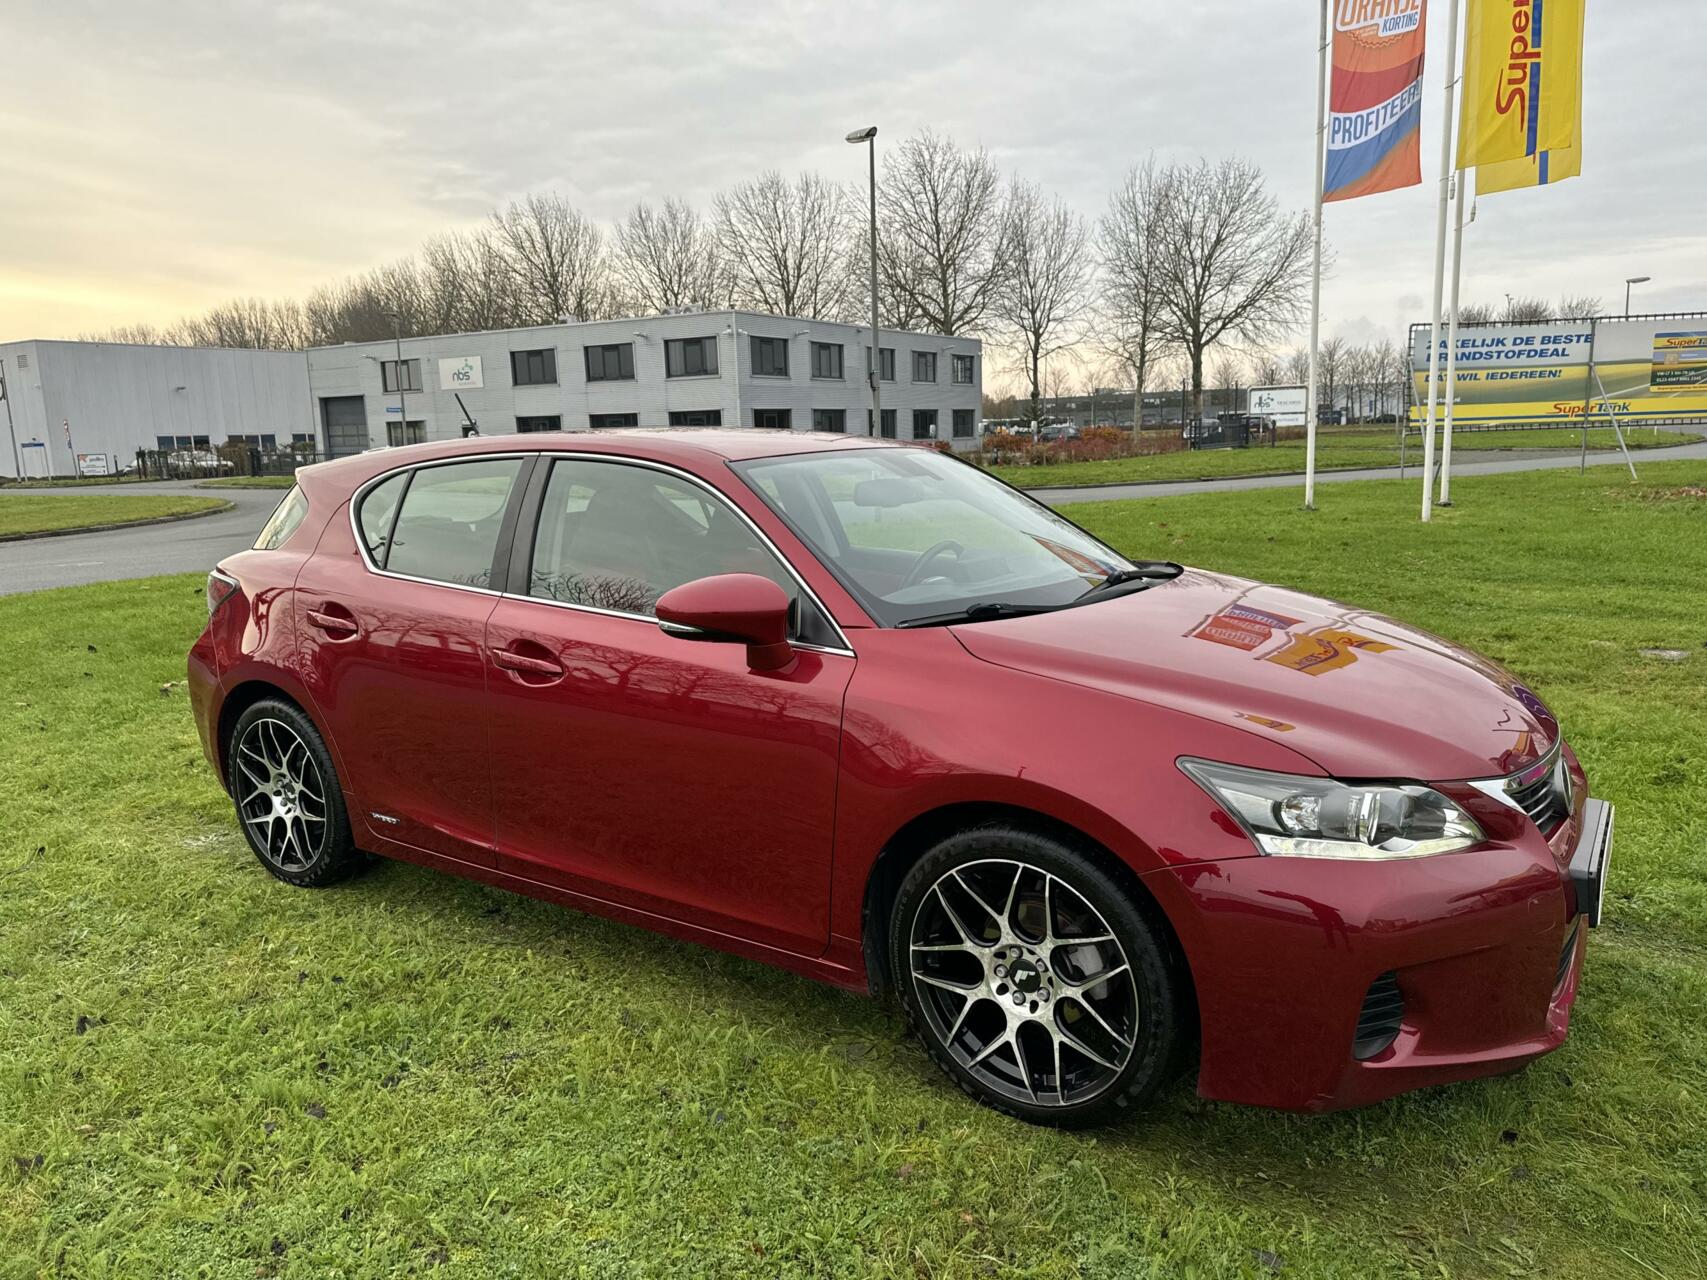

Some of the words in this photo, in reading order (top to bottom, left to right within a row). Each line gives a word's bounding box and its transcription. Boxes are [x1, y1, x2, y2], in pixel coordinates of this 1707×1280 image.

[1382, 12, 1419, 33] KORTING
[1512, 336, 1536, 346] DE
[1541, 334, 1594, 345] BESTE
[452, 369, 470, 382] nbs
[1456, 373, 1481, 382] WIL
[1485, 369, 1563, 381] IEDEREEN!
